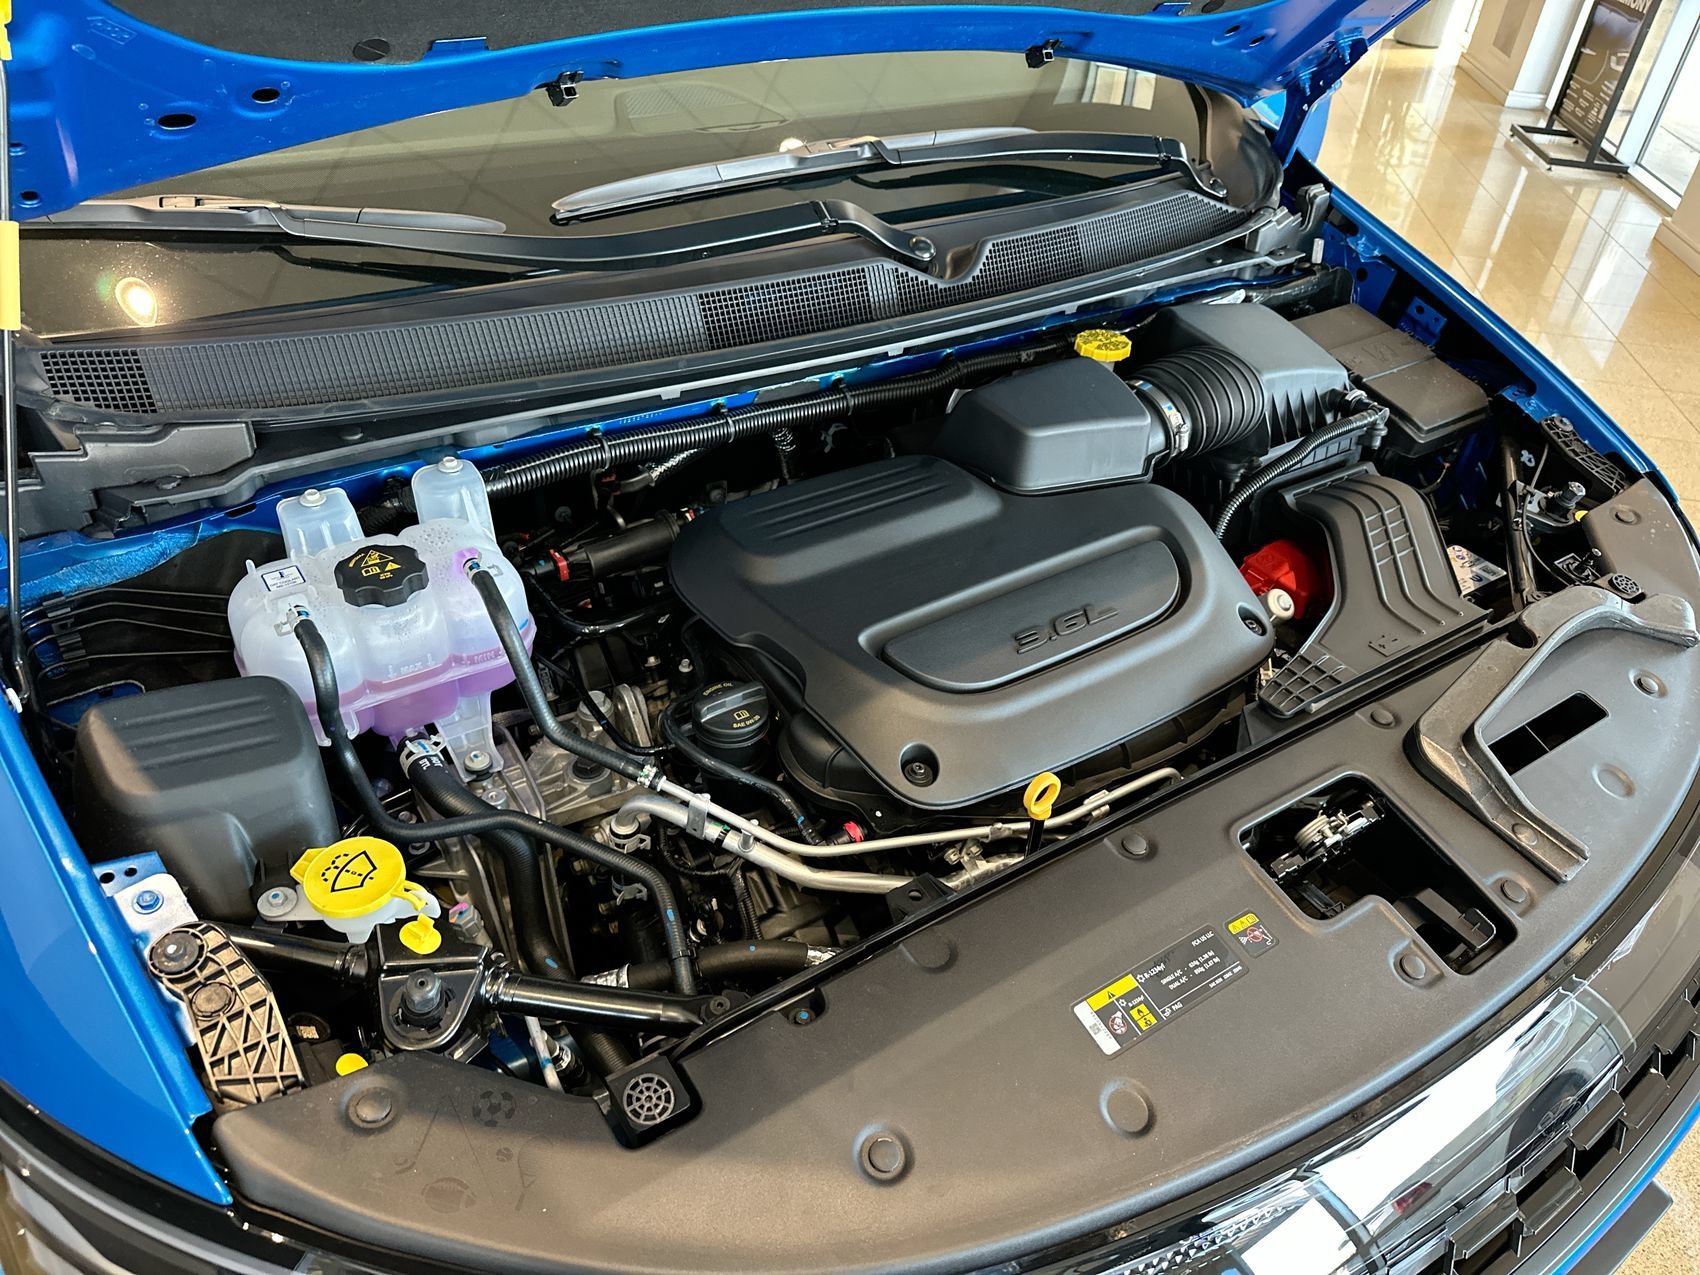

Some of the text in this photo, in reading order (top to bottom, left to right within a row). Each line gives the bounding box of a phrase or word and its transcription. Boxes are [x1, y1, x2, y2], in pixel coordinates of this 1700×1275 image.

[1014, 604, 1120, 654] 3.6L
[703, 684, 723, 696] ENGINE
[1144, 963, 1166, 979] R-1234yf
[1174, 969, 1183, 977] A/C
[1168, 979, 1180, 990] DUAL
[1179, 975, 1188, 983] A/C
[1172, 1002, 1183, 1011] PAG
